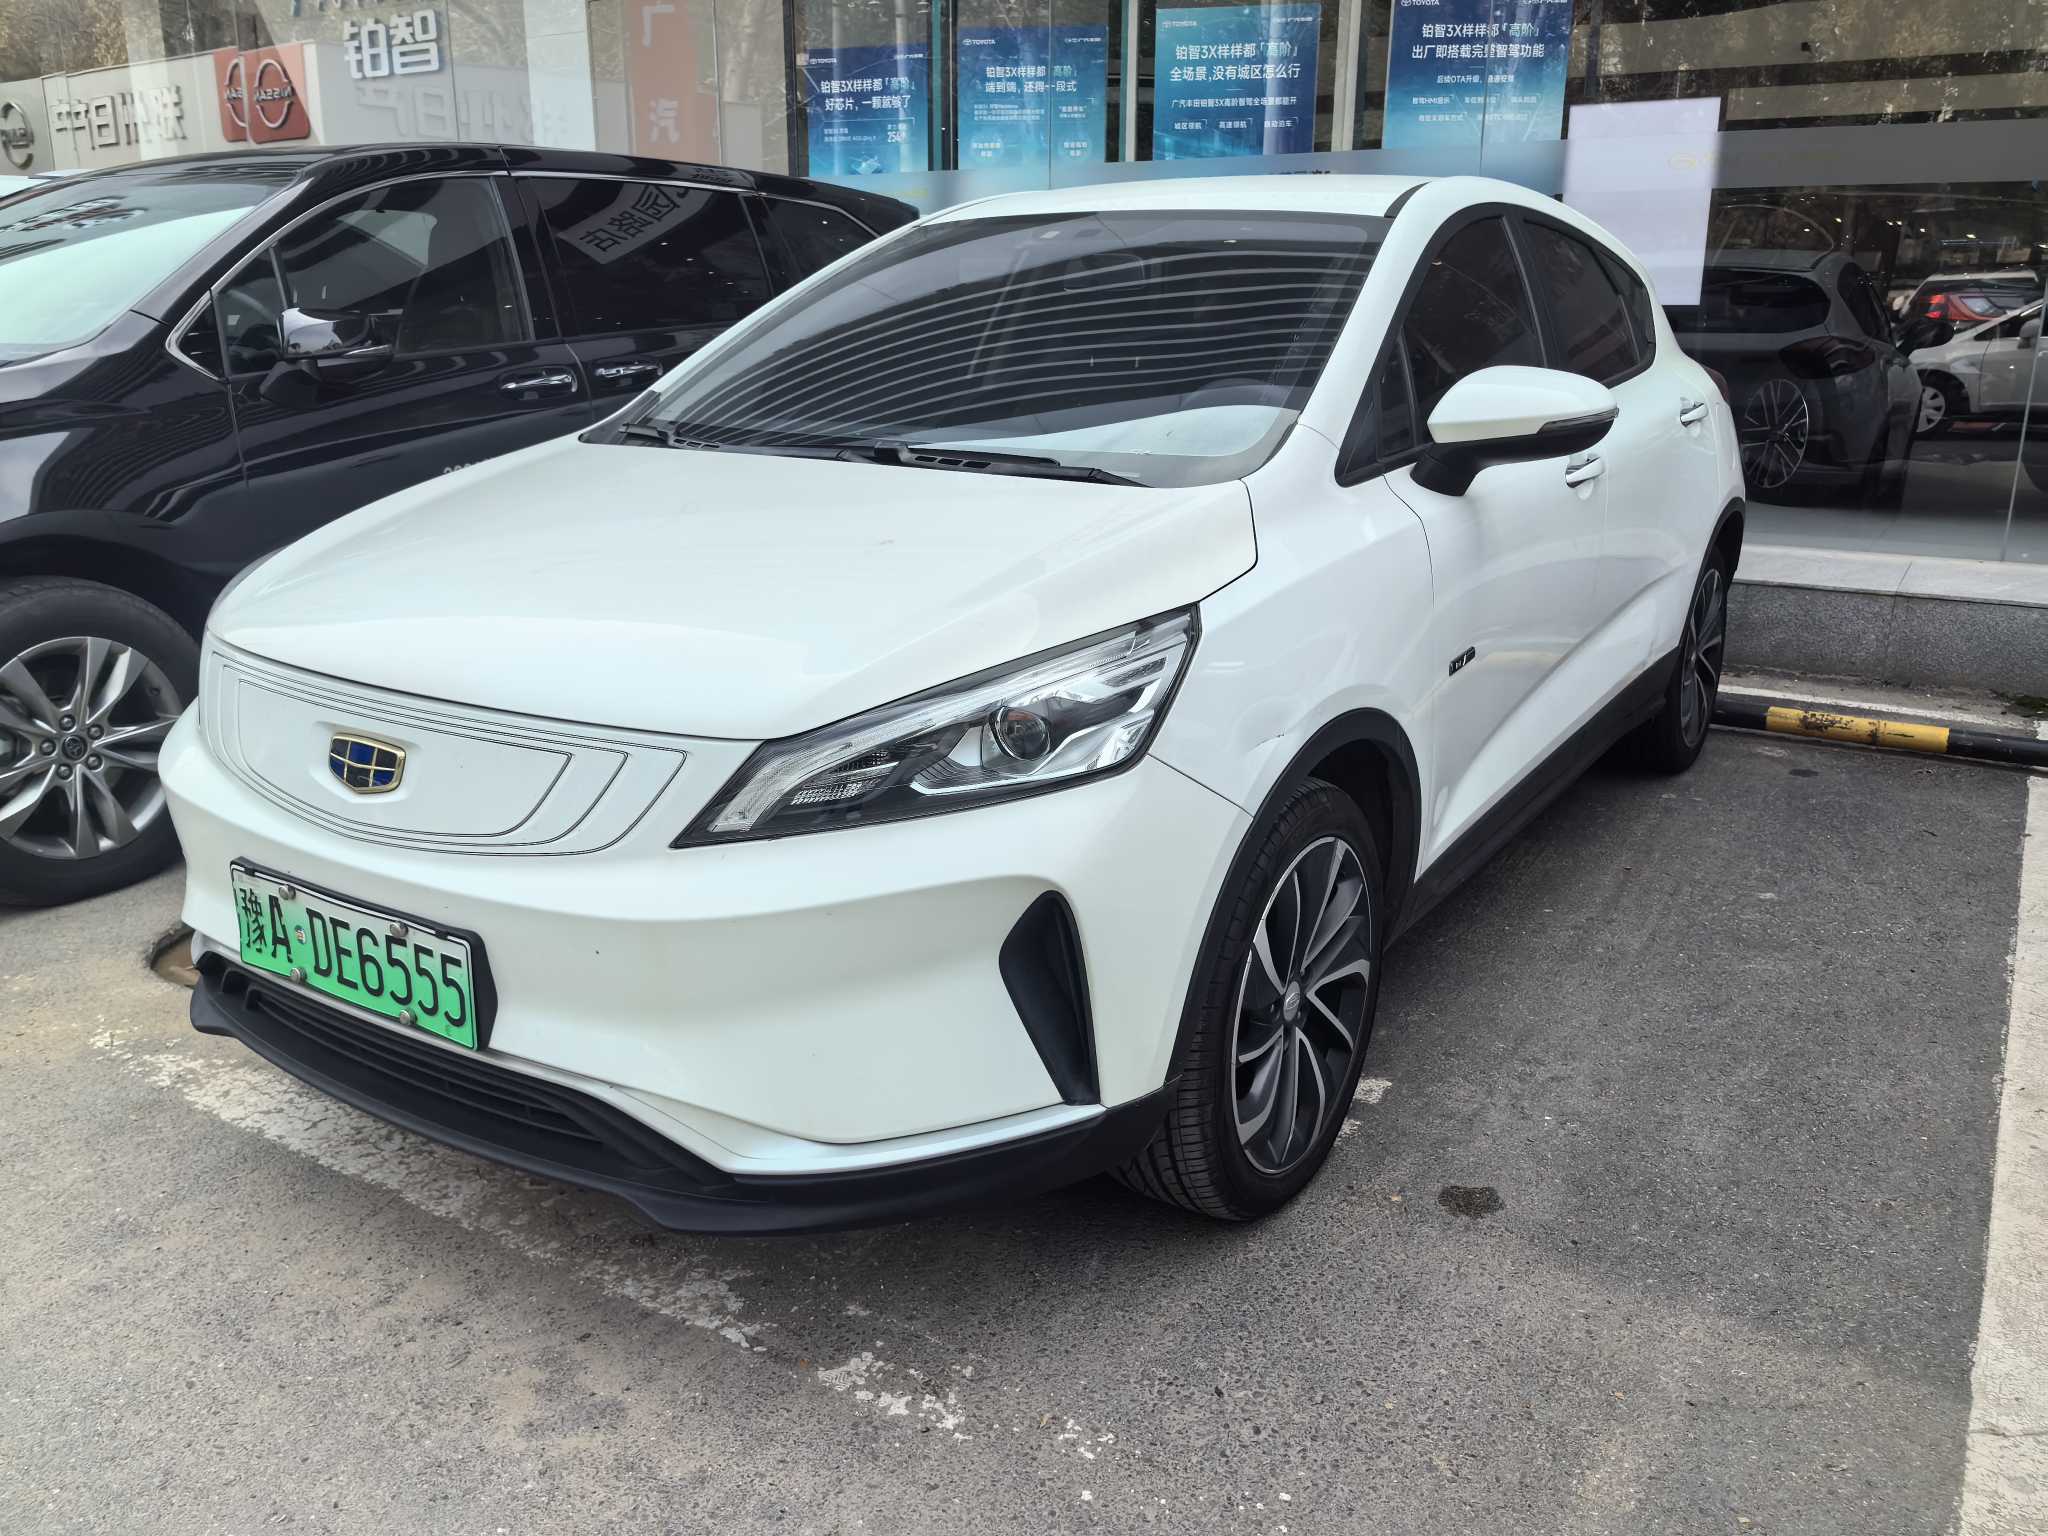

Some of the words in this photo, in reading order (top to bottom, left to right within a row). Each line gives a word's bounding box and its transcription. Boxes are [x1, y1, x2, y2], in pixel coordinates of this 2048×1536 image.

[343, 8, 441, 79] 铂智
[1411, 43, 1545, 59] 出厂即搭载完整智驾功能
